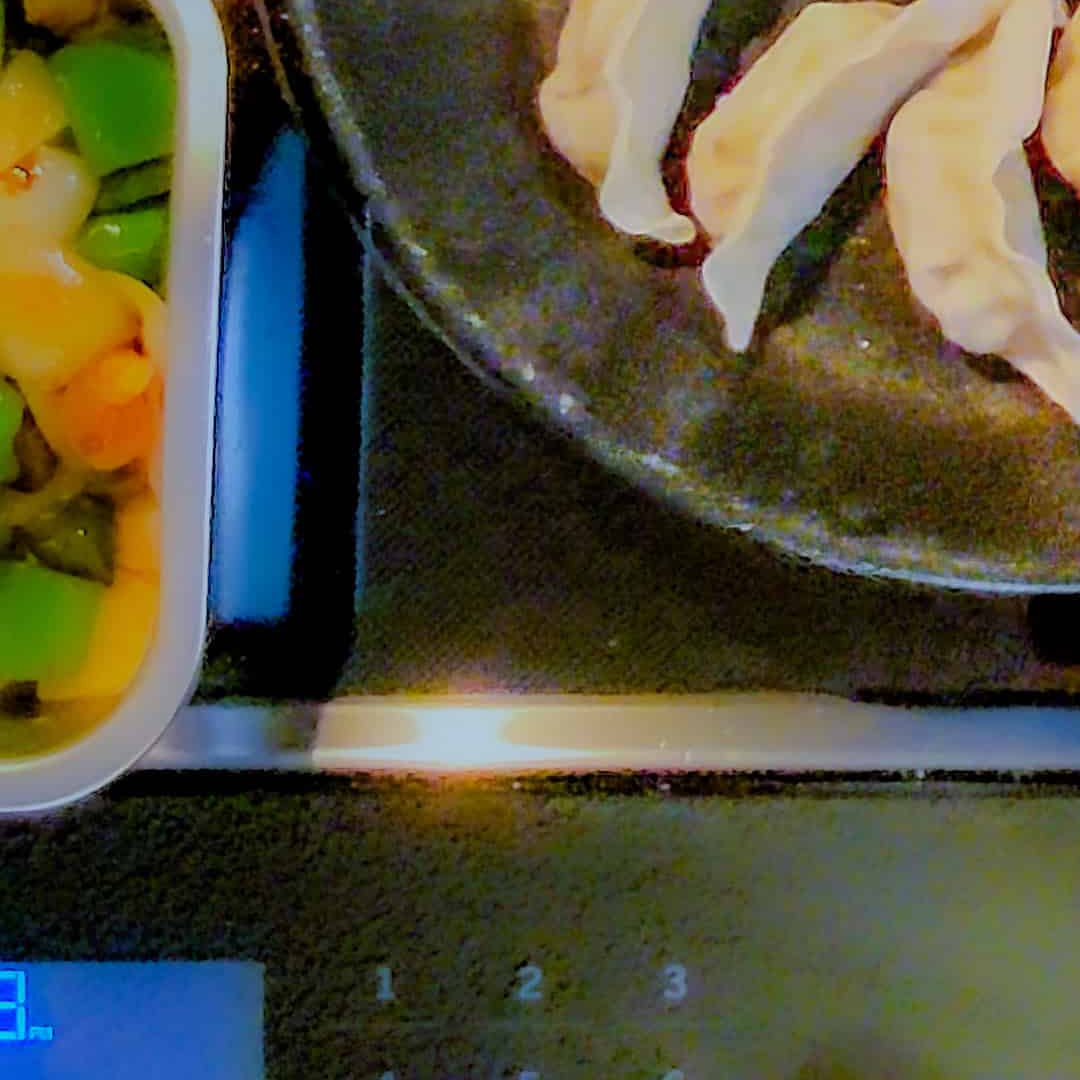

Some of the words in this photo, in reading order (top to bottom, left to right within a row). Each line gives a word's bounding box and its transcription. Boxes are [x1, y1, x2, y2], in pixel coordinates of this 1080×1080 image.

[376, 968, 395, 1000] 1
[519, 966, 542, 1000] 2
[664, 964, 687, 1000] 3
